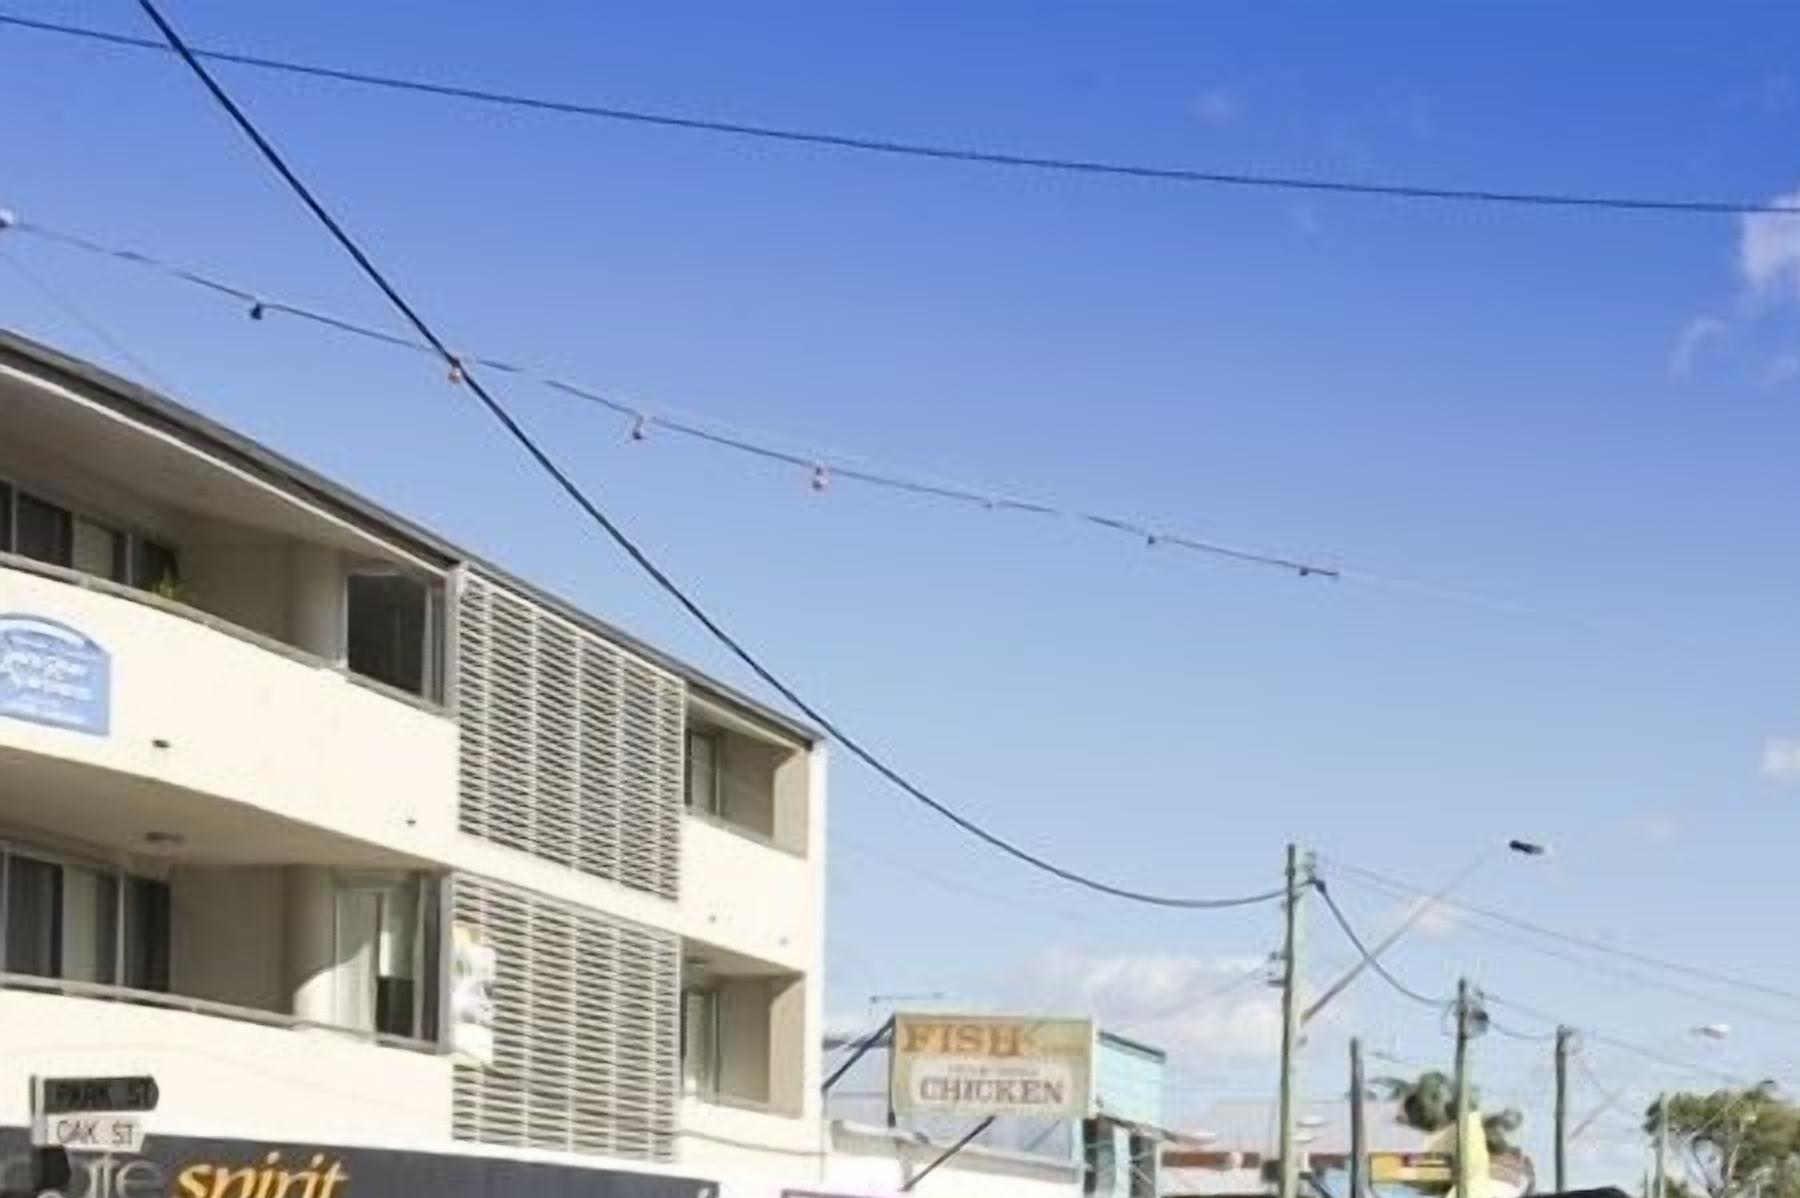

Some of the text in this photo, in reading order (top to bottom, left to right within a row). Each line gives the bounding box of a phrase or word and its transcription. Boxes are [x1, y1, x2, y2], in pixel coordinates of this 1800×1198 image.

[903, 1023, 1023, 1058] FISH
[920, 1076, 1065, 1104] CHICKEN
[57, 1120, 132, 1145] OAK ST
